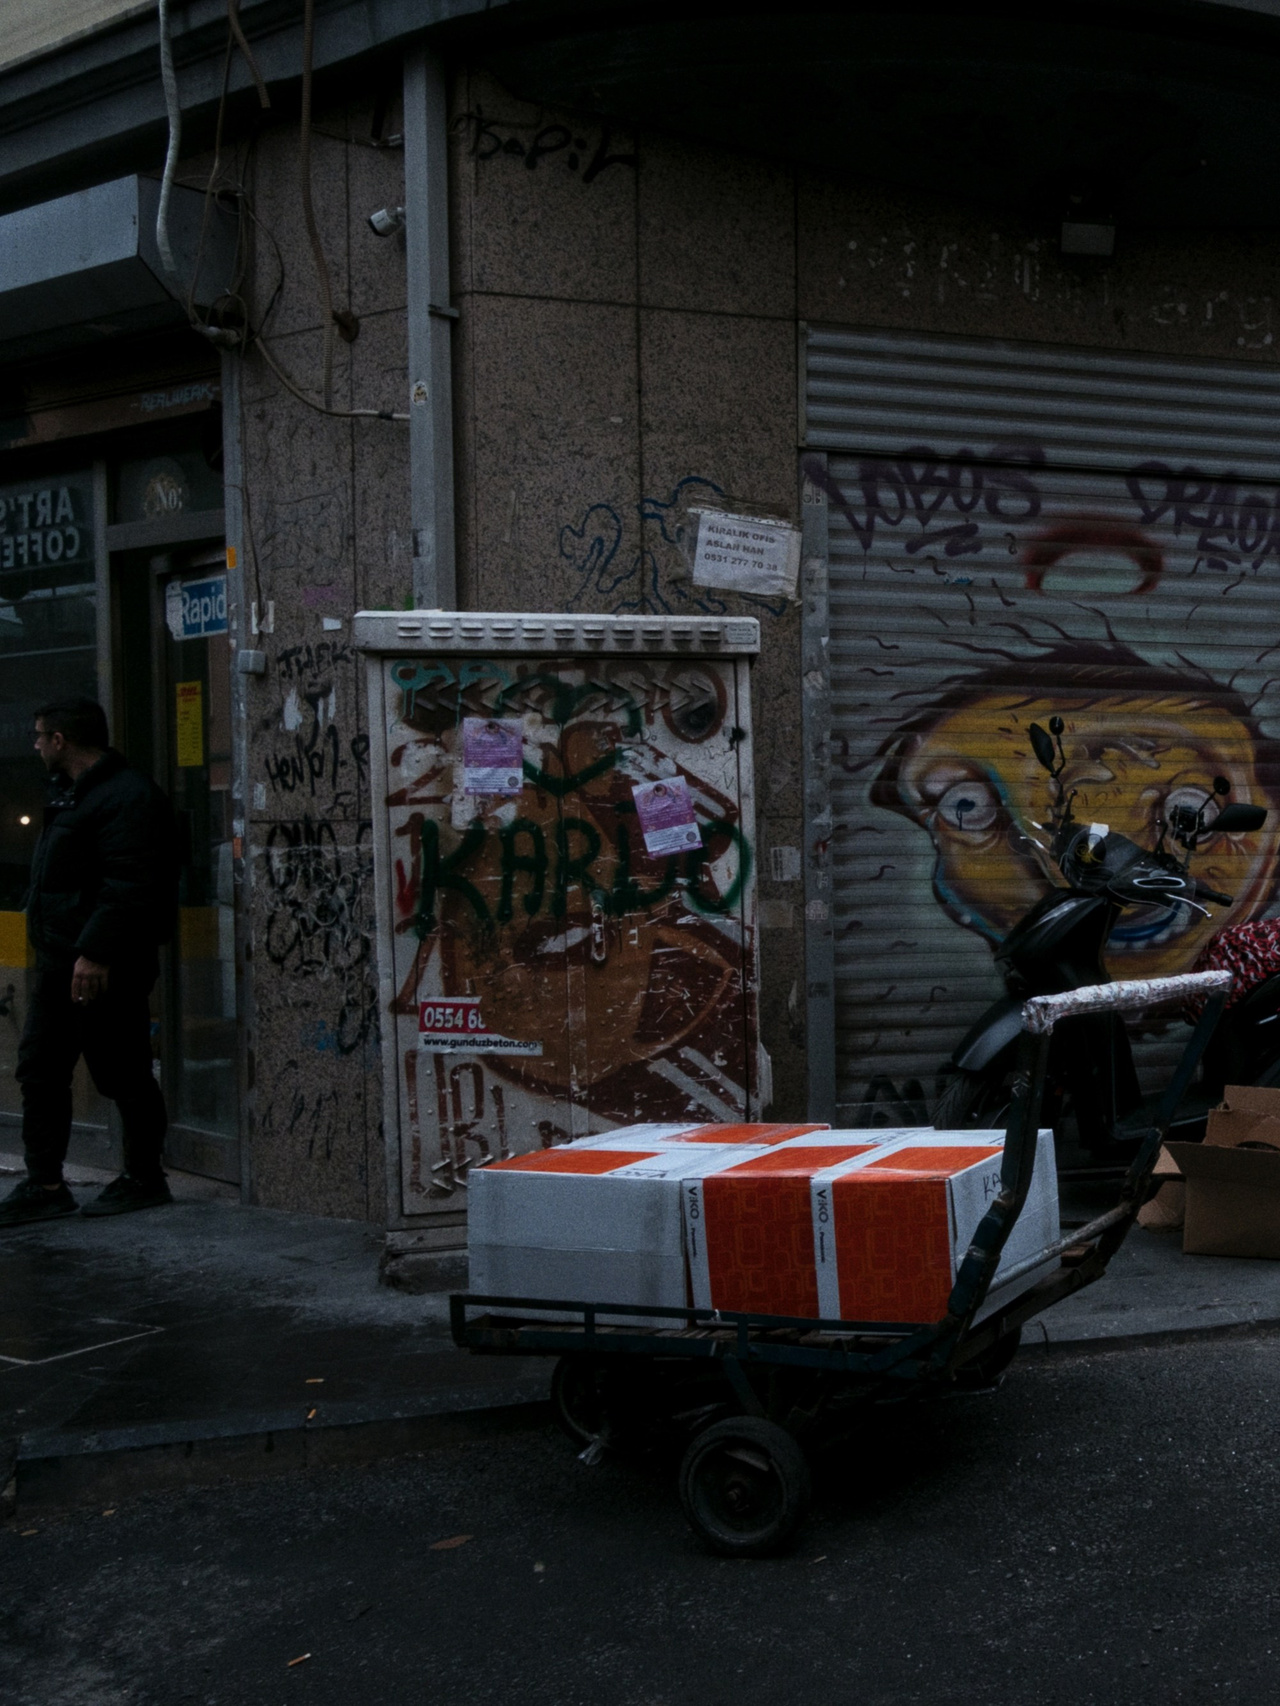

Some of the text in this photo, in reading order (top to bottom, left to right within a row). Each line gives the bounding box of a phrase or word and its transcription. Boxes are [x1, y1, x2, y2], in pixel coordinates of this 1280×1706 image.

[708, 525, 775, 544] KİRALIK OFİS
[706, 540, 764, 555] ASLAN HAN
[704, 553, 728, 563] 0531
[731, 557, 748, 566] 277
[752, 560, 763, 569] 70
[183, 583, 227, 633] Rapid
[424, 1006, 464, 1029] 0554
